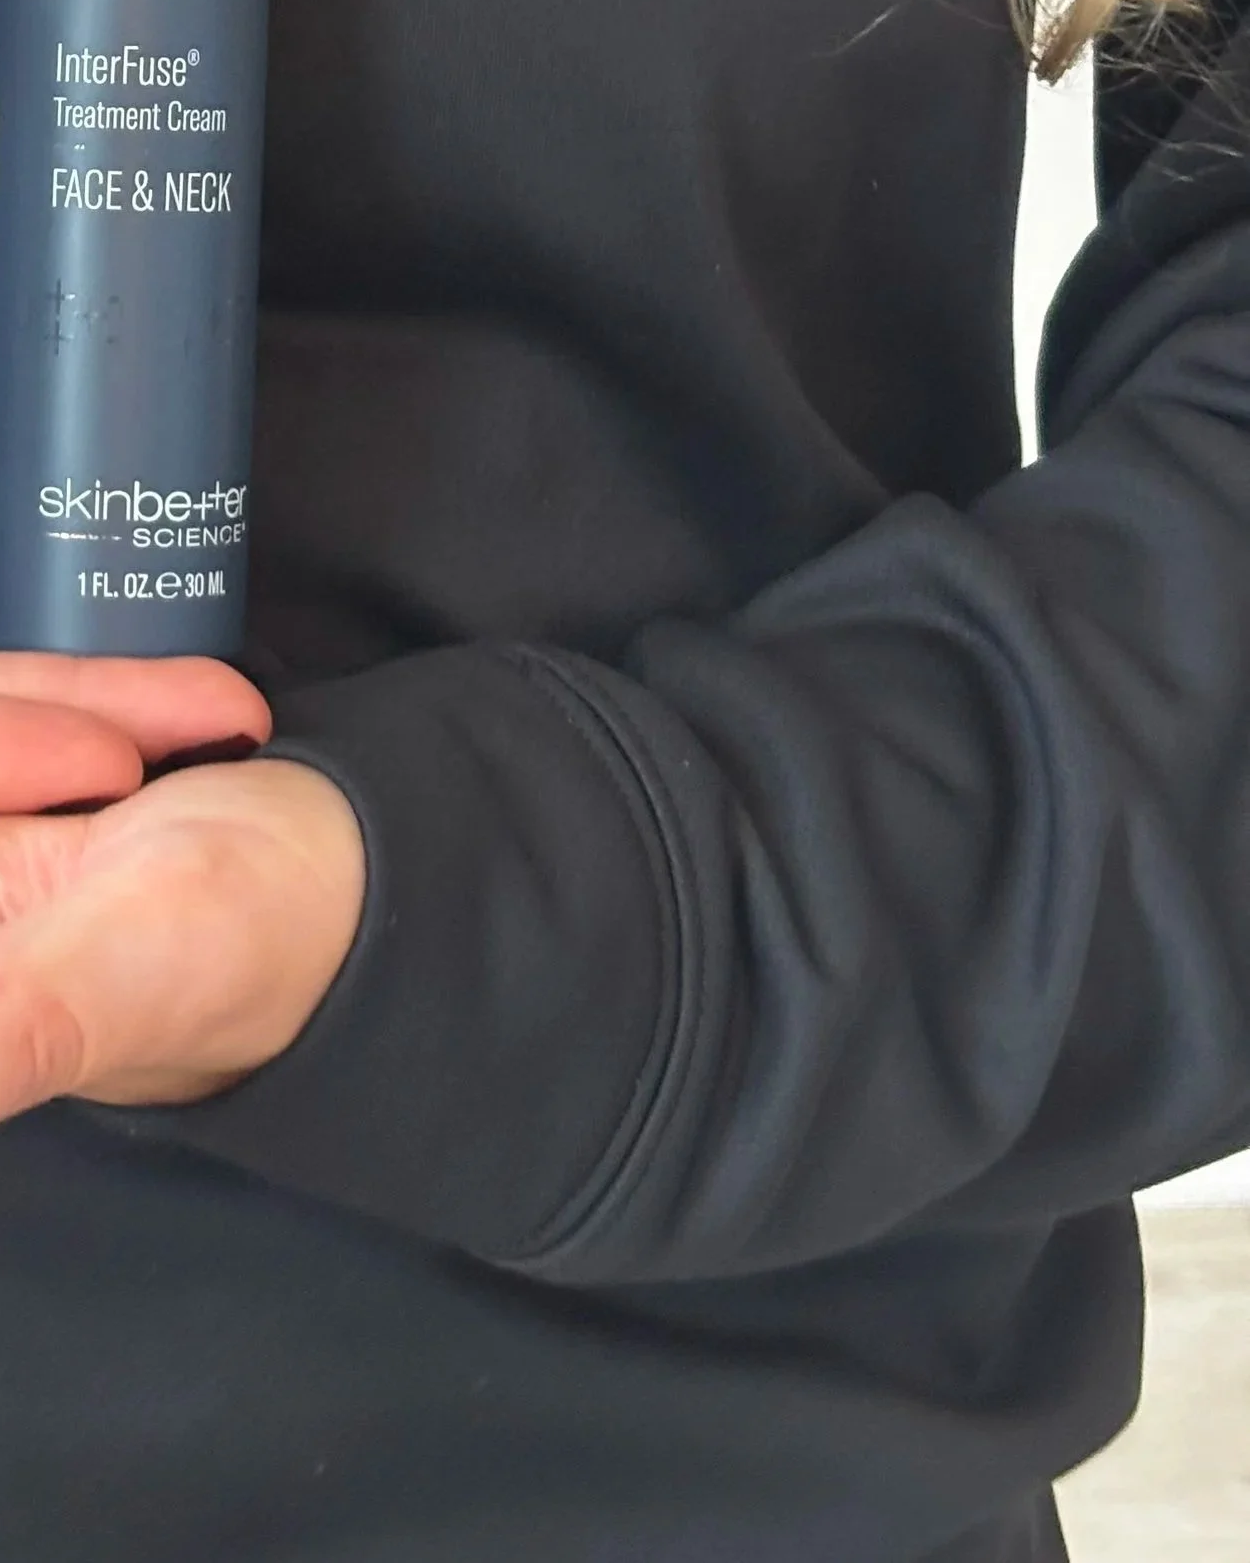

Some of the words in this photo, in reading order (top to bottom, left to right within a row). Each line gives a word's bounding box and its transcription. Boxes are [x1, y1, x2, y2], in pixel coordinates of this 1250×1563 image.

[53, 96, 162, 131] Treatment
[167, 100, 227, 132] Cream
[51, 167, 123, 211] FACE
[131, 169, 155, 212] &
[164, 171, 232, 213] NECK
[38, 477, 248, 522] skinbetter
[77, 571, 87, 597] 1
[92, 571, 119, 598] FL.
[123, 572, 154, 599] OZ.
[184, 572, 205, 597] 30
[208, 570, 227, 596] ML
